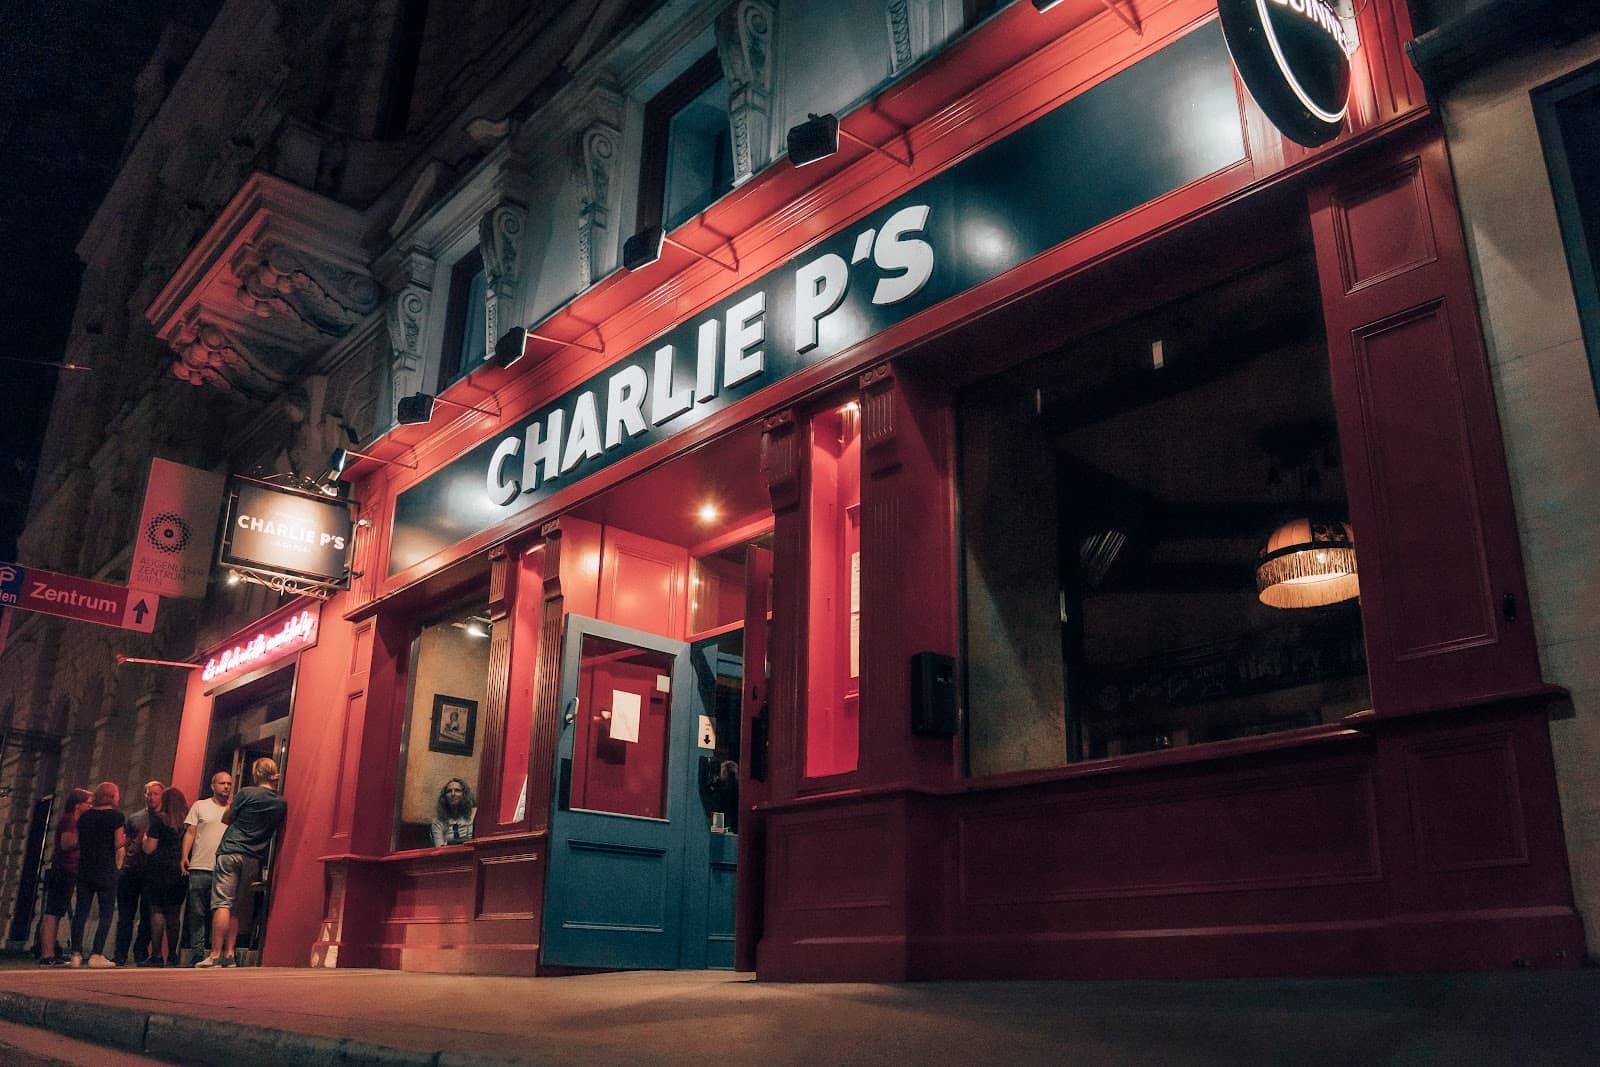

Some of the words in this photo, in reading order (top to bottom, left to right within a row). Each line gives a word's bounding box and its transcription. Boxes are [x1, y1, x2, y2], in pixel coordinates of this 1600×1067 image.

[486, 291, 766, 506] CHARLIE
[795, 205, 934, 354] P'S
[238, 515, 315, 544] CHARLIE
[319, 532, 345, 550] P'S
[138, 566, 186, 583] ZENTRUM
[30, 581, 117, 614] Zentrum
